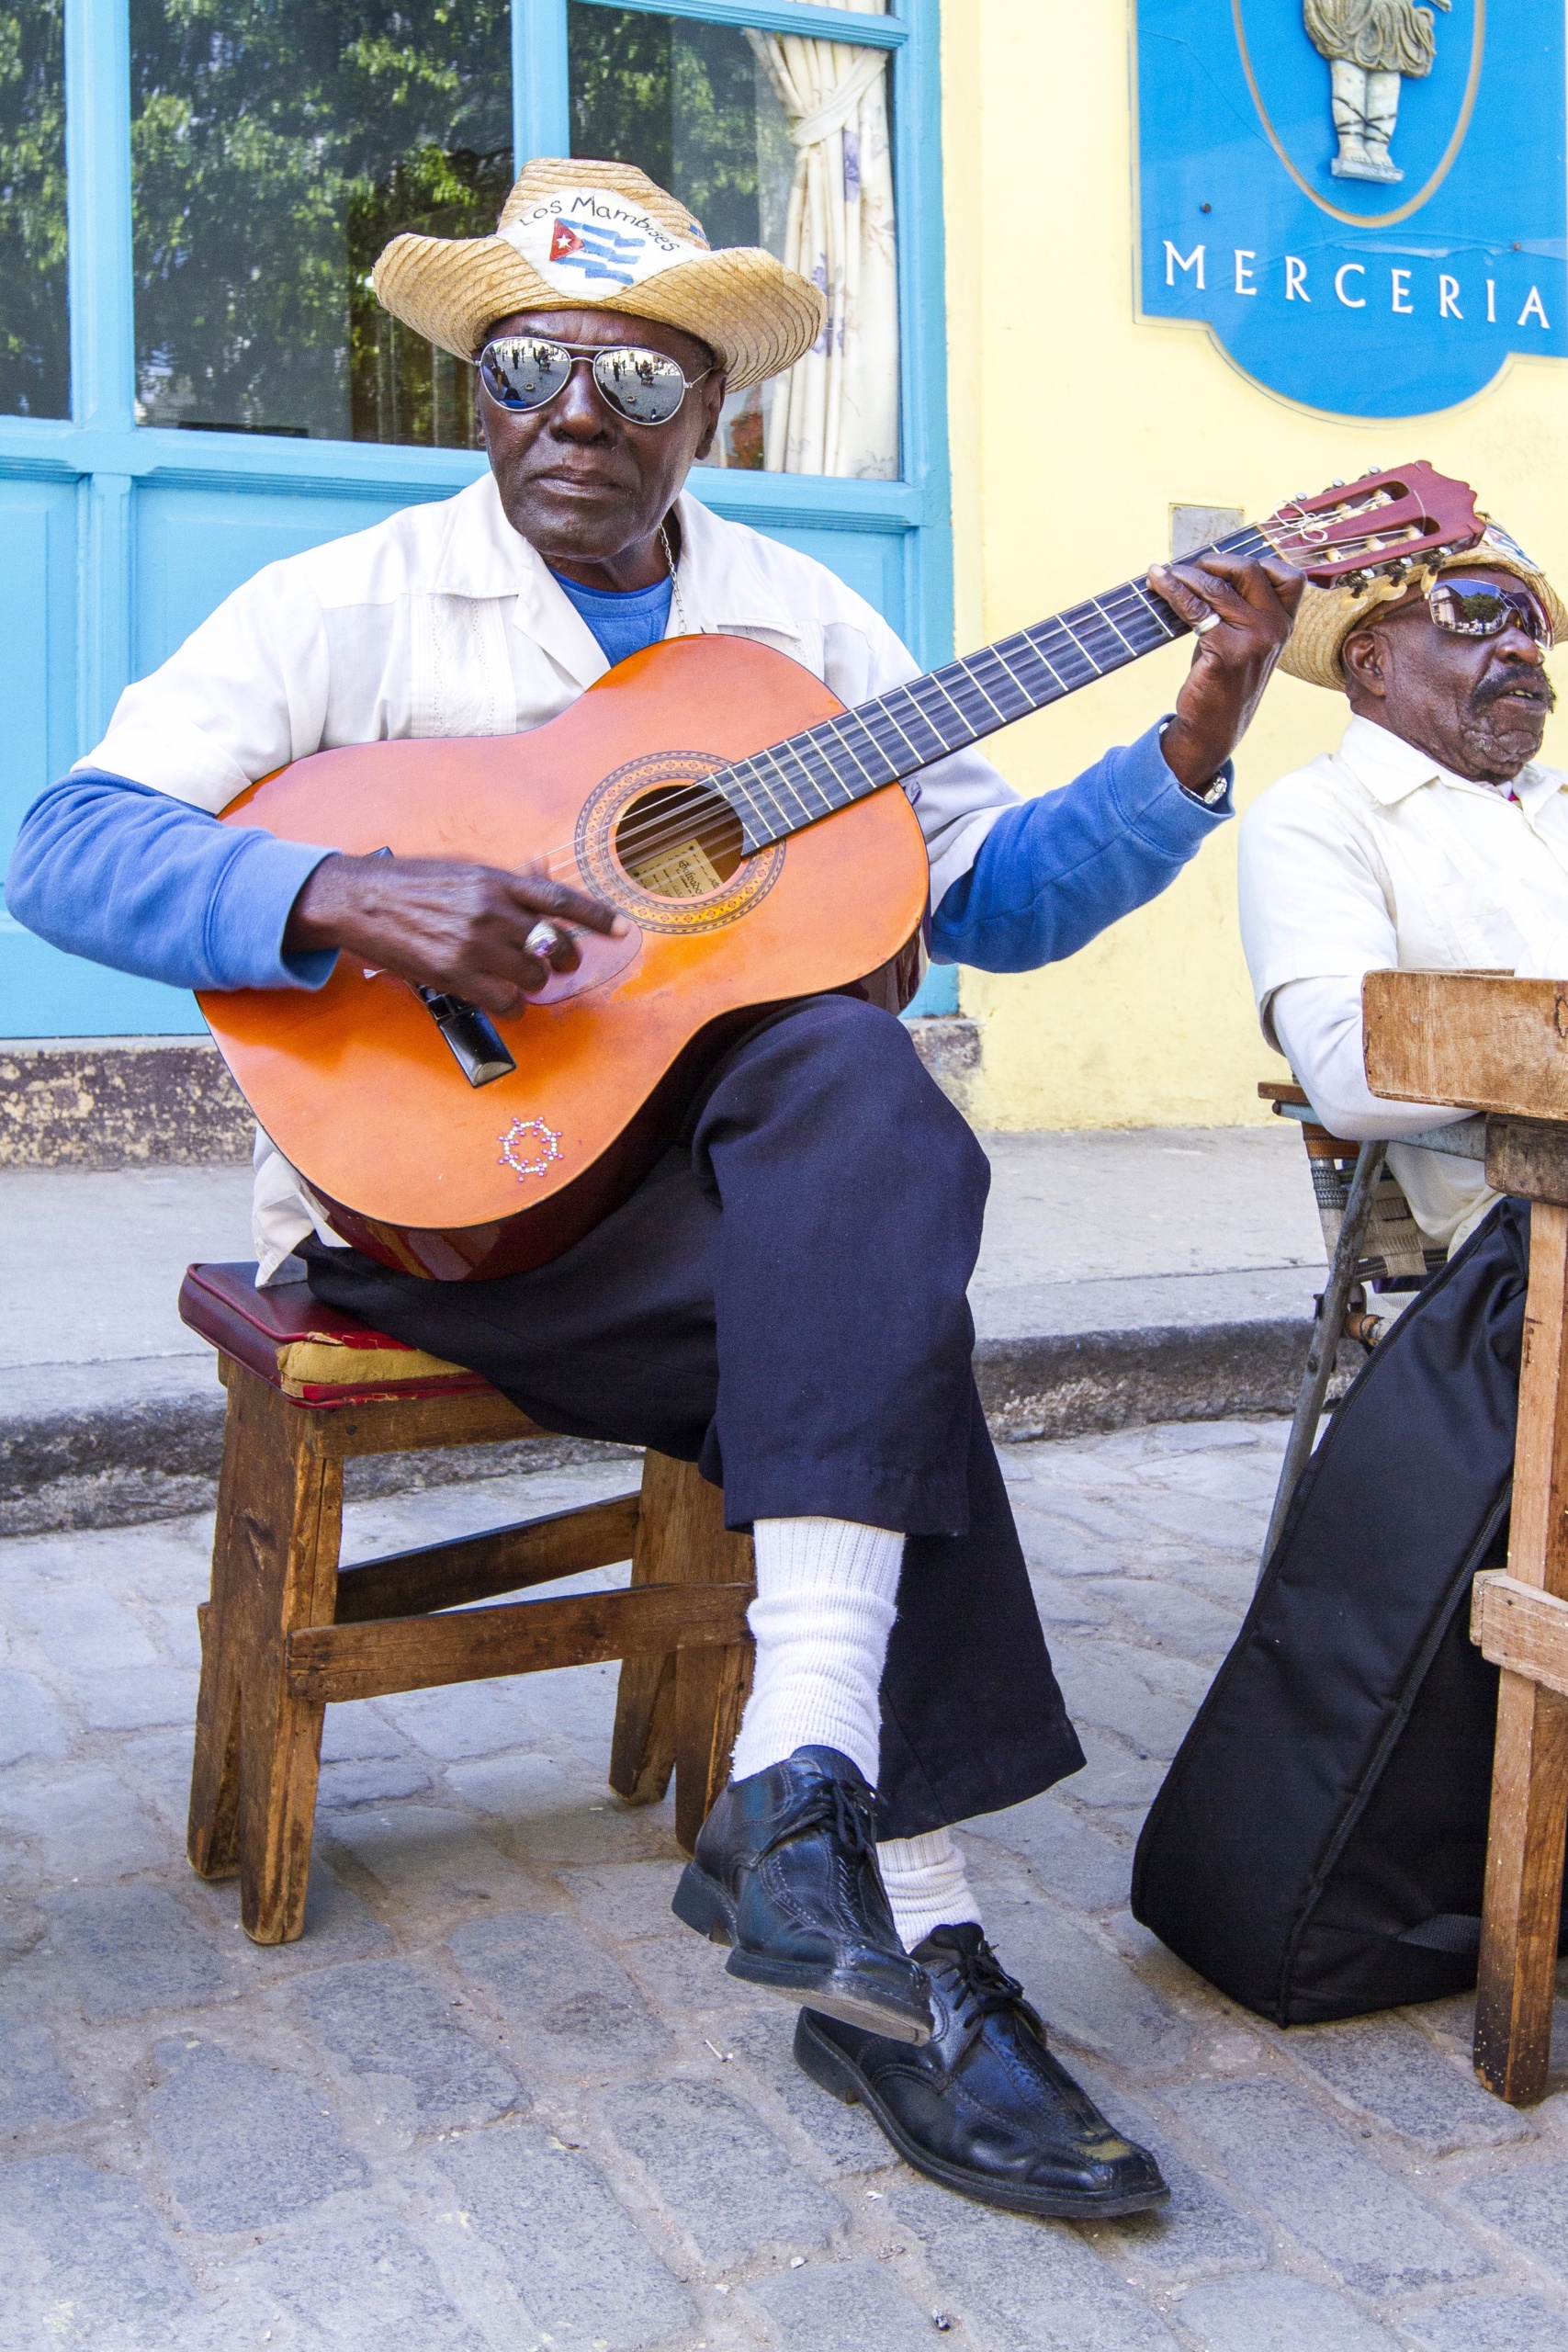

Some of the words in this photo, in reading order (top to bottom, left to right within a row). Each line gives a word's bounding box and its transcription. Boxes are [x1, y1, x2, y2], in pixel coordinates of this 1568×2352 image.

[570, 196, 681, 252] Mambises
[1162, 240, 1551, 329] MERCERIA
[679, 860, 705, 895] Salvado
